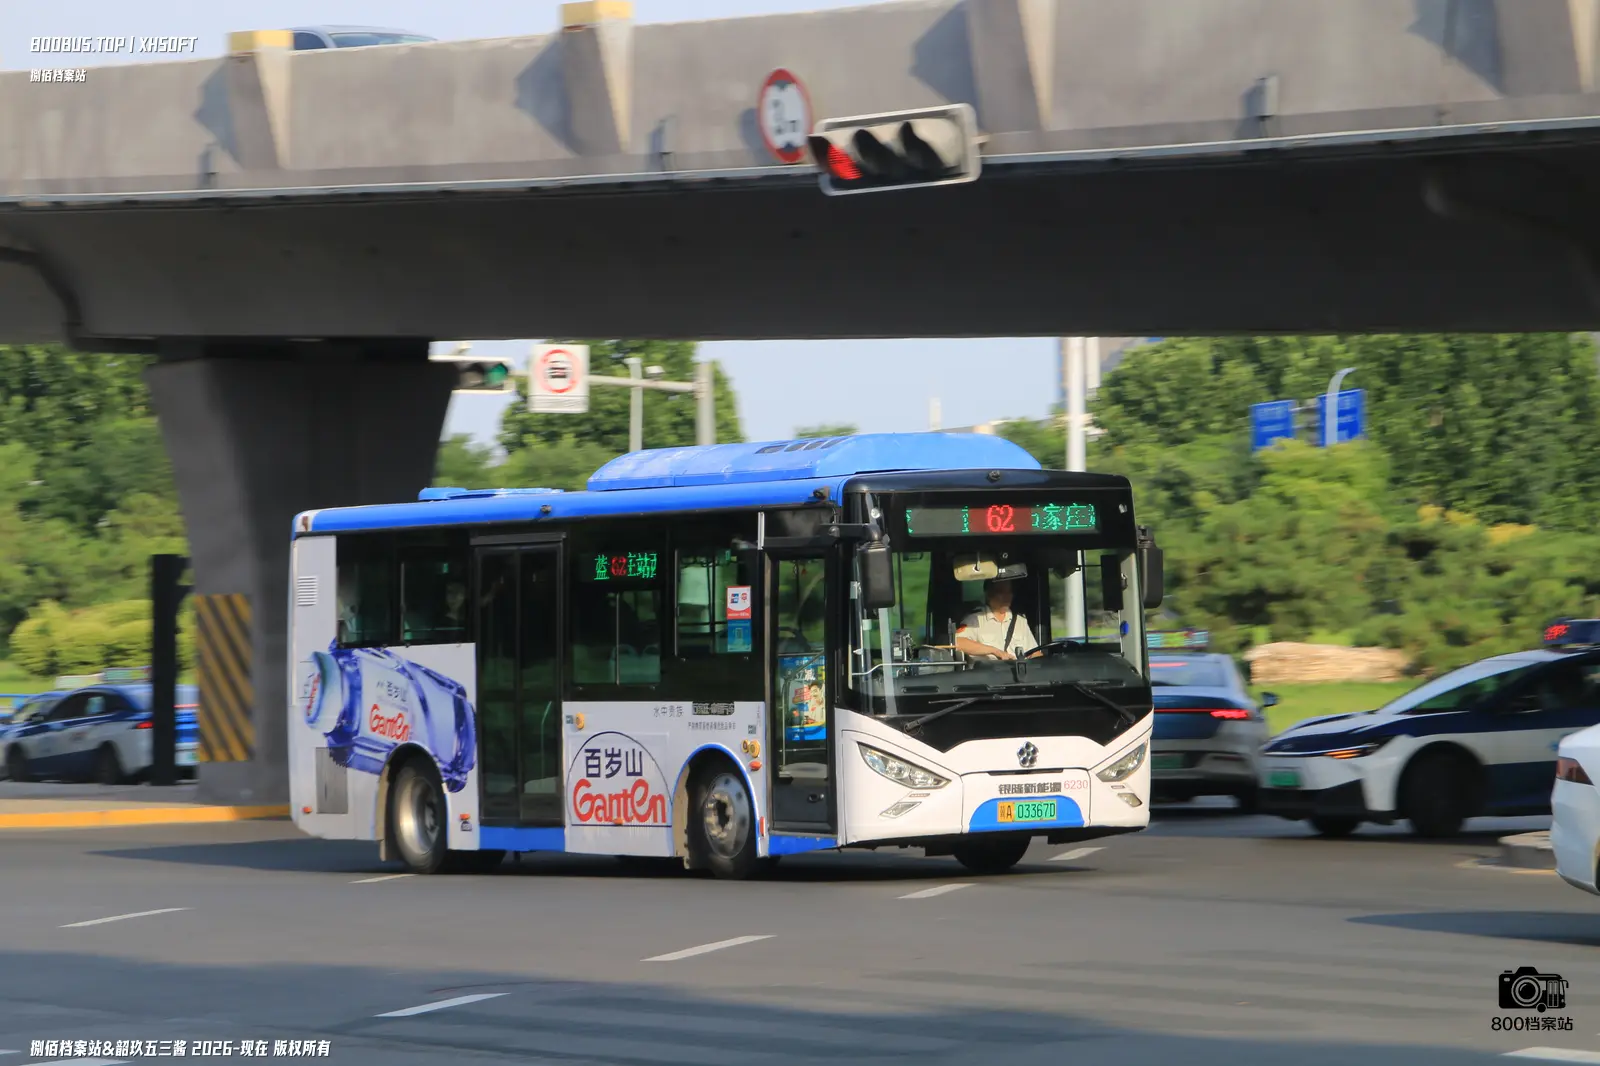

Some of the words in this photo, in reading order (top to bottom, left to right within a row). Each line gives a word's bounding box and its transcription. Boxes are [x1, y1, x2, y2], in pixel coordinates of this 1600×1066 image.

[986, 504, 1015, 532] 62
[610, 556, 627, 576] 62
[584, 747, 643, 778] 百岁山
[998, 782, 1062, 795] 银隆新能源
[1064, 779, 1089, 790] 6230
[573, 778, 667, 823] Ganten
